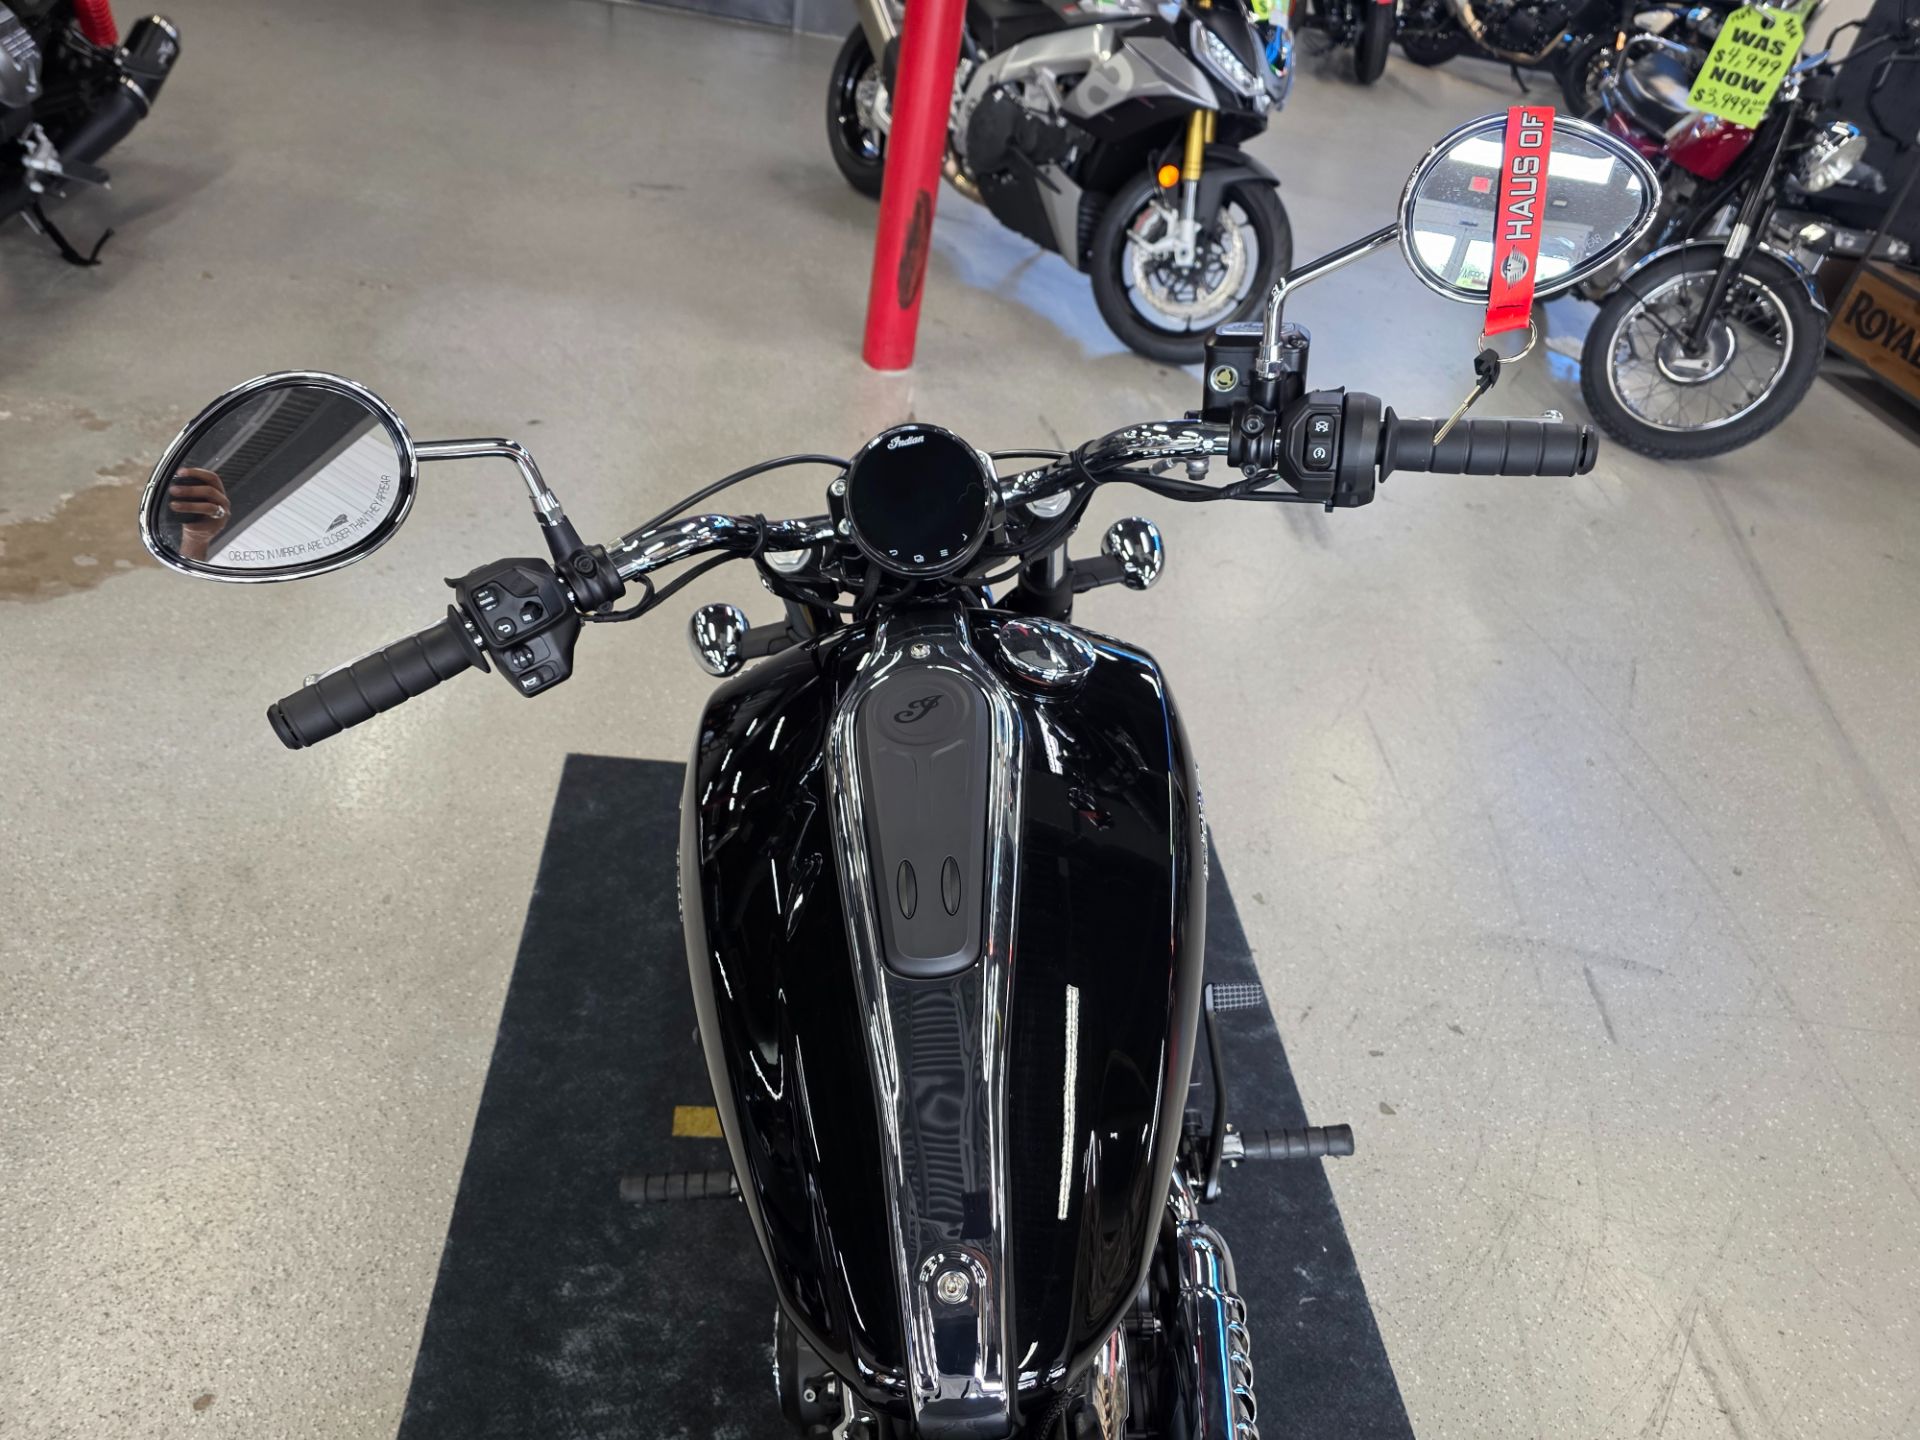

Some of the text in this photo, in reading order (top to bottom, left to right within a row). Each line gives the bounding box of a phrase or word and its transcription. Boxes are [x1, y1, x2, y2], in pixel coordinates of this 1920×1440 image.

[1731, 28, 1787, 56] WAS
[1714, 47, 1782, 77] $4,999
[1709, 67, 1767, 95] NOW
[1505, 112, 1545, 241] HAUS OF
[887, 435, 925, 450] Indian
[229, 474, 391, 562] OBJECTS IN MIRROR ARE CLOSER THAN THEY APPEAR
